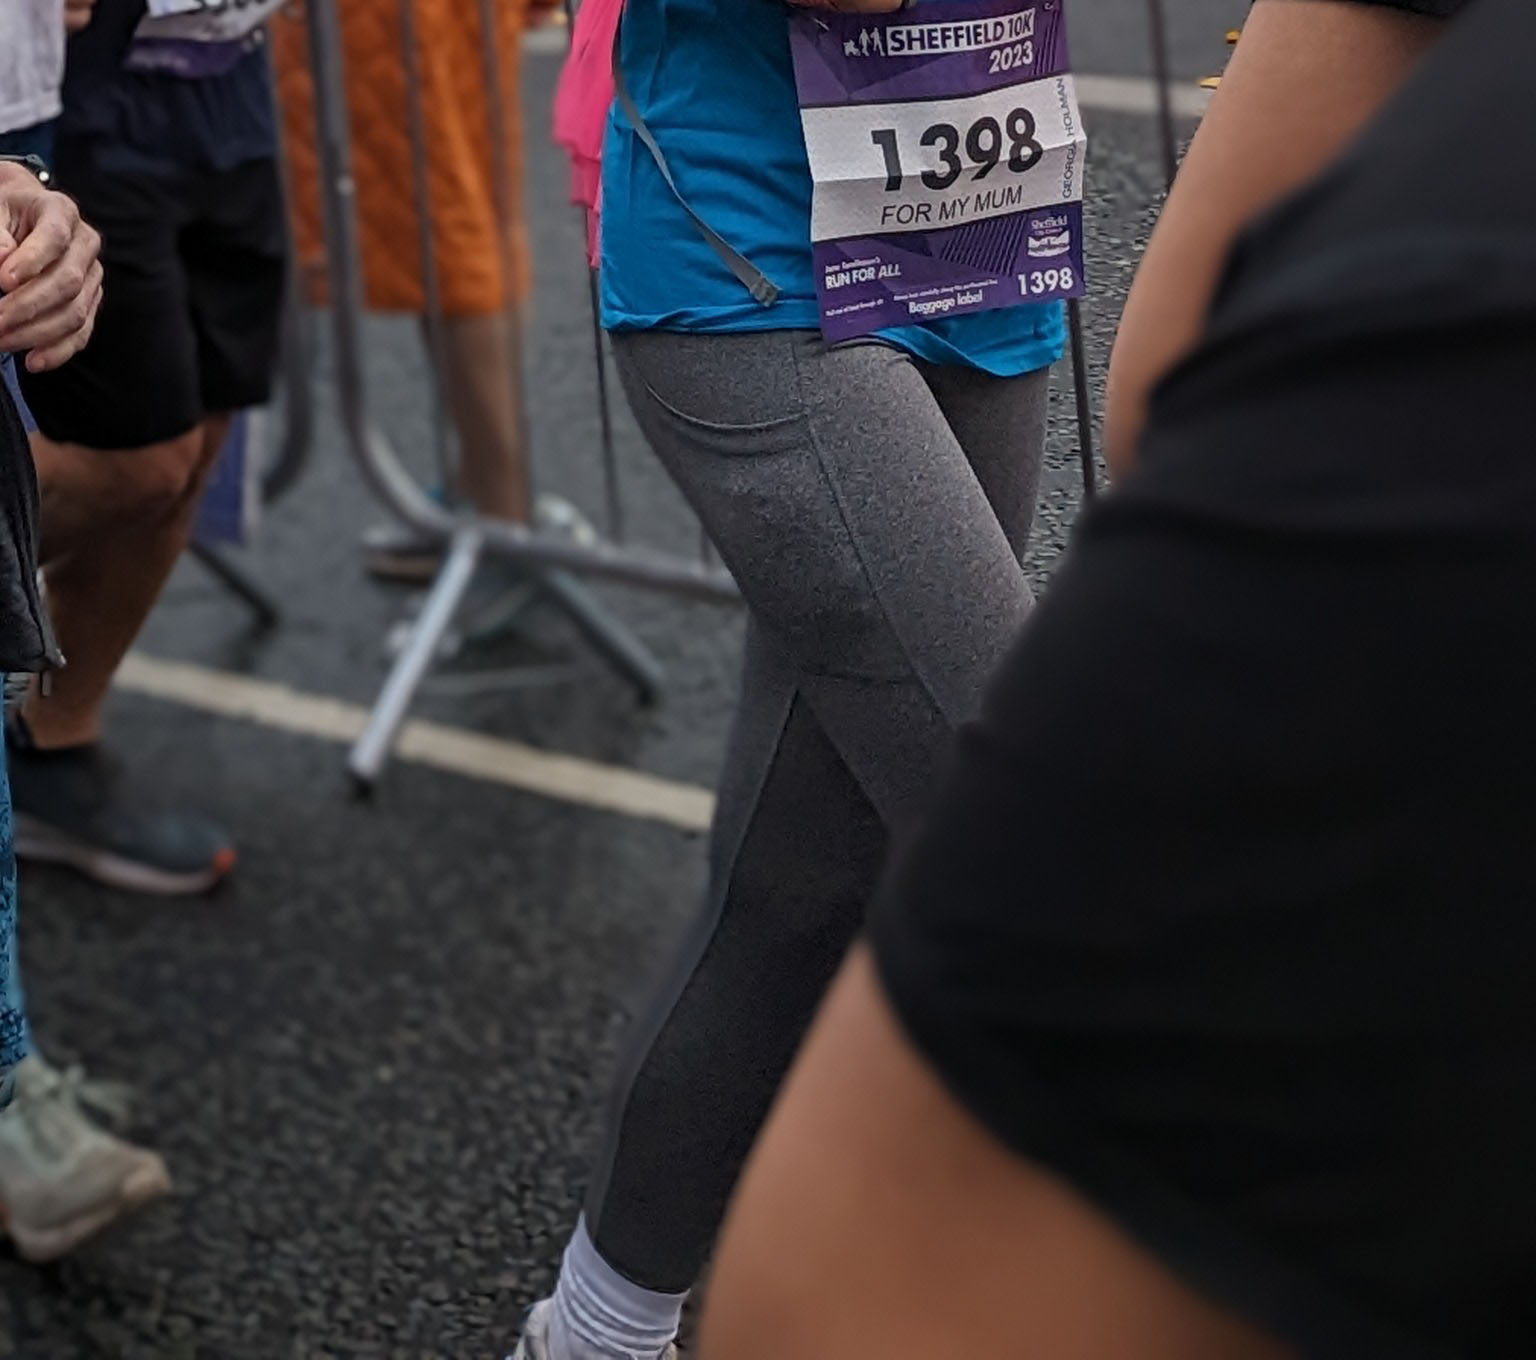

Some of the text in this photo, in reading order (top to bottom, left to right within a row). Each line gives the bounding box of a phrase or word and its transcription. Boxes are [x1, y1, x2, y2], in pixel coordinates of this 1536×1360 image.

[890, 14, 1032, 52] SHEFFIELD 10K
[988, 41, 1033, 74] 2023
[871, 107, 1043, 192] 1398
[881, 185, 1023, 225] FOR MY MUM
[825, 264, 901, 289] RUN FOR ALL
[1018, 267, 1073, 295] 1398
